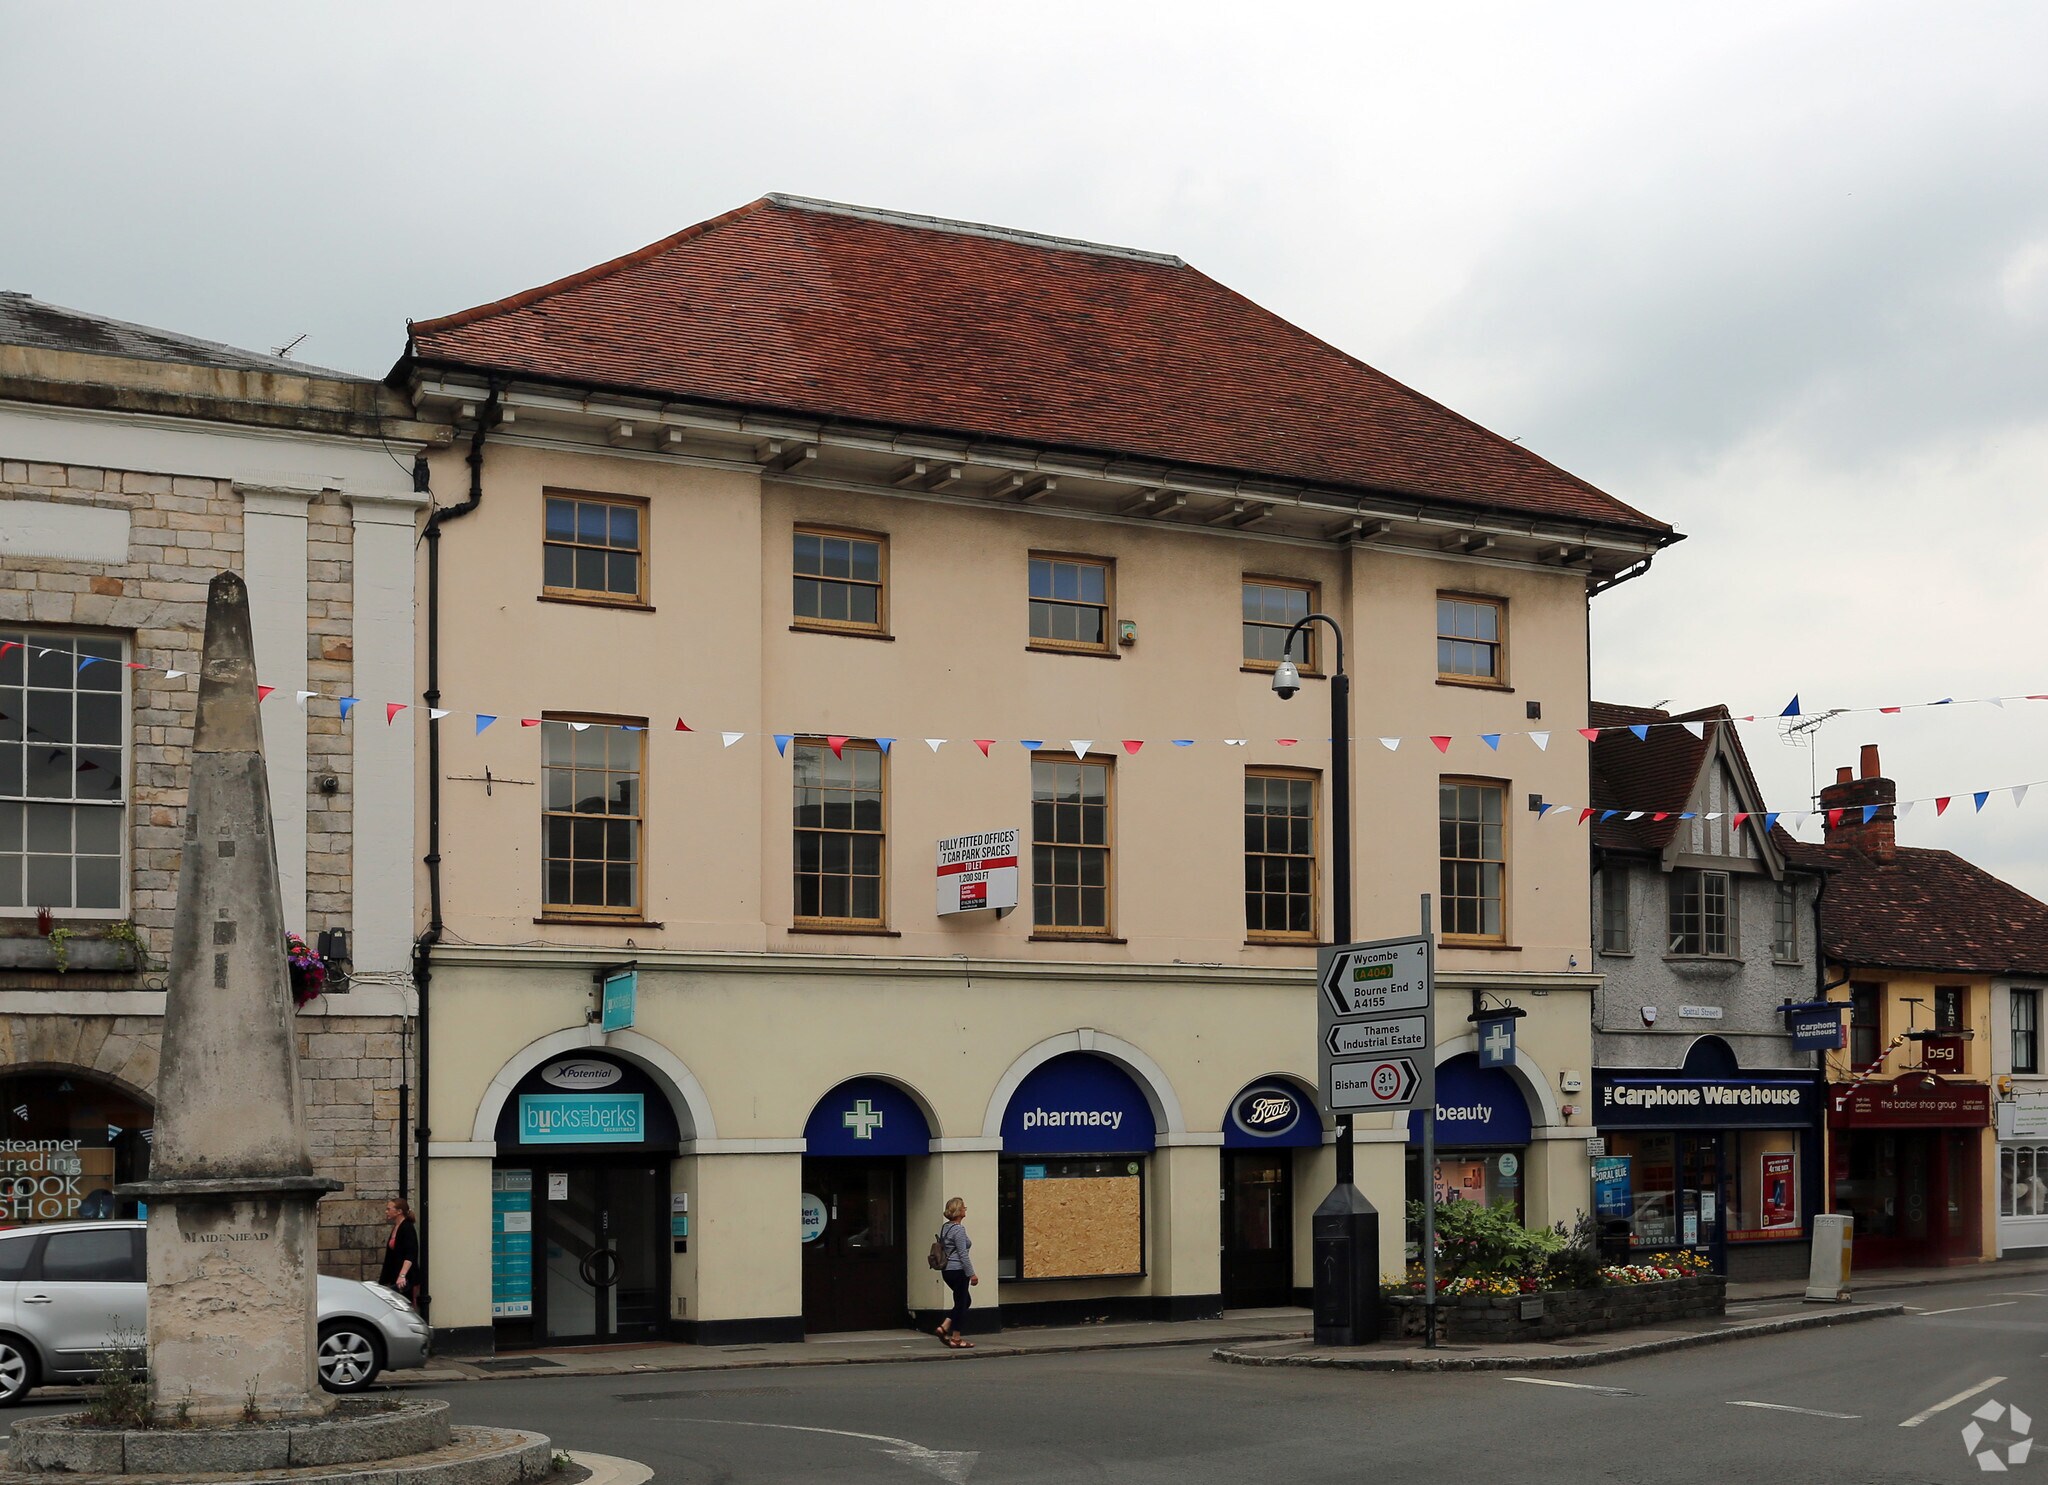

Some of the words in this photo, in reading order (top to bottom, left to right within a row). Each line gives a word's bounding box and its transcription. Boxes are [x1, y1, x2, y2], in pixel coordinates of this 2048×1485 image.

[940, 838, 958, 851] FULLY
[960, 834, 982, 848] FITTED
[984, 830, 1014, 845] OFFICES
[942, 853, 946, 864] 7
[948, 850, 960, 863] CAR
[961, 848, 980, 861] PARK
[982, 844, 1010, 858] SPACES
[965, 862, 972, 871] TO
[972, 860, 982, 870] LET
[982, 871, 989, 880] FT
[1353, 951, 1398, 965] Wycombe
[1416, 946, 1424, 957] 4
[1354, 966, 1393, 981] (A404)
[1354, 986, 1387, 997] Bourne
[1390, 983, 1409, 993] End
[1417, 980, 1424, 990] 3
[1354, 996, 1385, 1009] A4155
[1701, 1008, 1719, 1017] Street
[1363, 1025, 1400, 1036] Thames
[1796, 1028, 1837, 1038] Warehouse
[1800, 1021, 1837, 1031] Carphone
[1343, 1036, 1388, 1050] Industrial
[1391, 1033, 1422, 1046] Estate
[1927, 1046, 1954, 1060] bsg
[1335, 1079, 1368, 1090] Bisham
[1604, 1086, 1613, 1106] THE
[1613, 1085, 1701, 1108] Carphone
[1702, 1085, 1801, 1105] Warehouse
[1247, 1098, 1292, 1124] Boots
[1881, 1101, 1892, 1109] the
[1894, 1099, 1918, 1109] barber
[1919, 1100, 1935, 1111] shop
[1937, 1101, 1957, 1111] group
[1023, 1106, 1124, 1132] pharmacy
[1436, 1103, 1493, 1124] beauty
[0, 1138, 82, 1153] steamer
[1434, 1166, 1443, 1181] 3
[1615, 1167, 1627, 1178] BLUE
[0, 1176, 81, 1197] COOK
[1435, 1182, 1445, 1190] for
[1435, 1191, 1443, 1204] 2
[0, 1198, 82, 1219] SHOP
[184, 1232, 269, 1243] MAIDENHEAD
